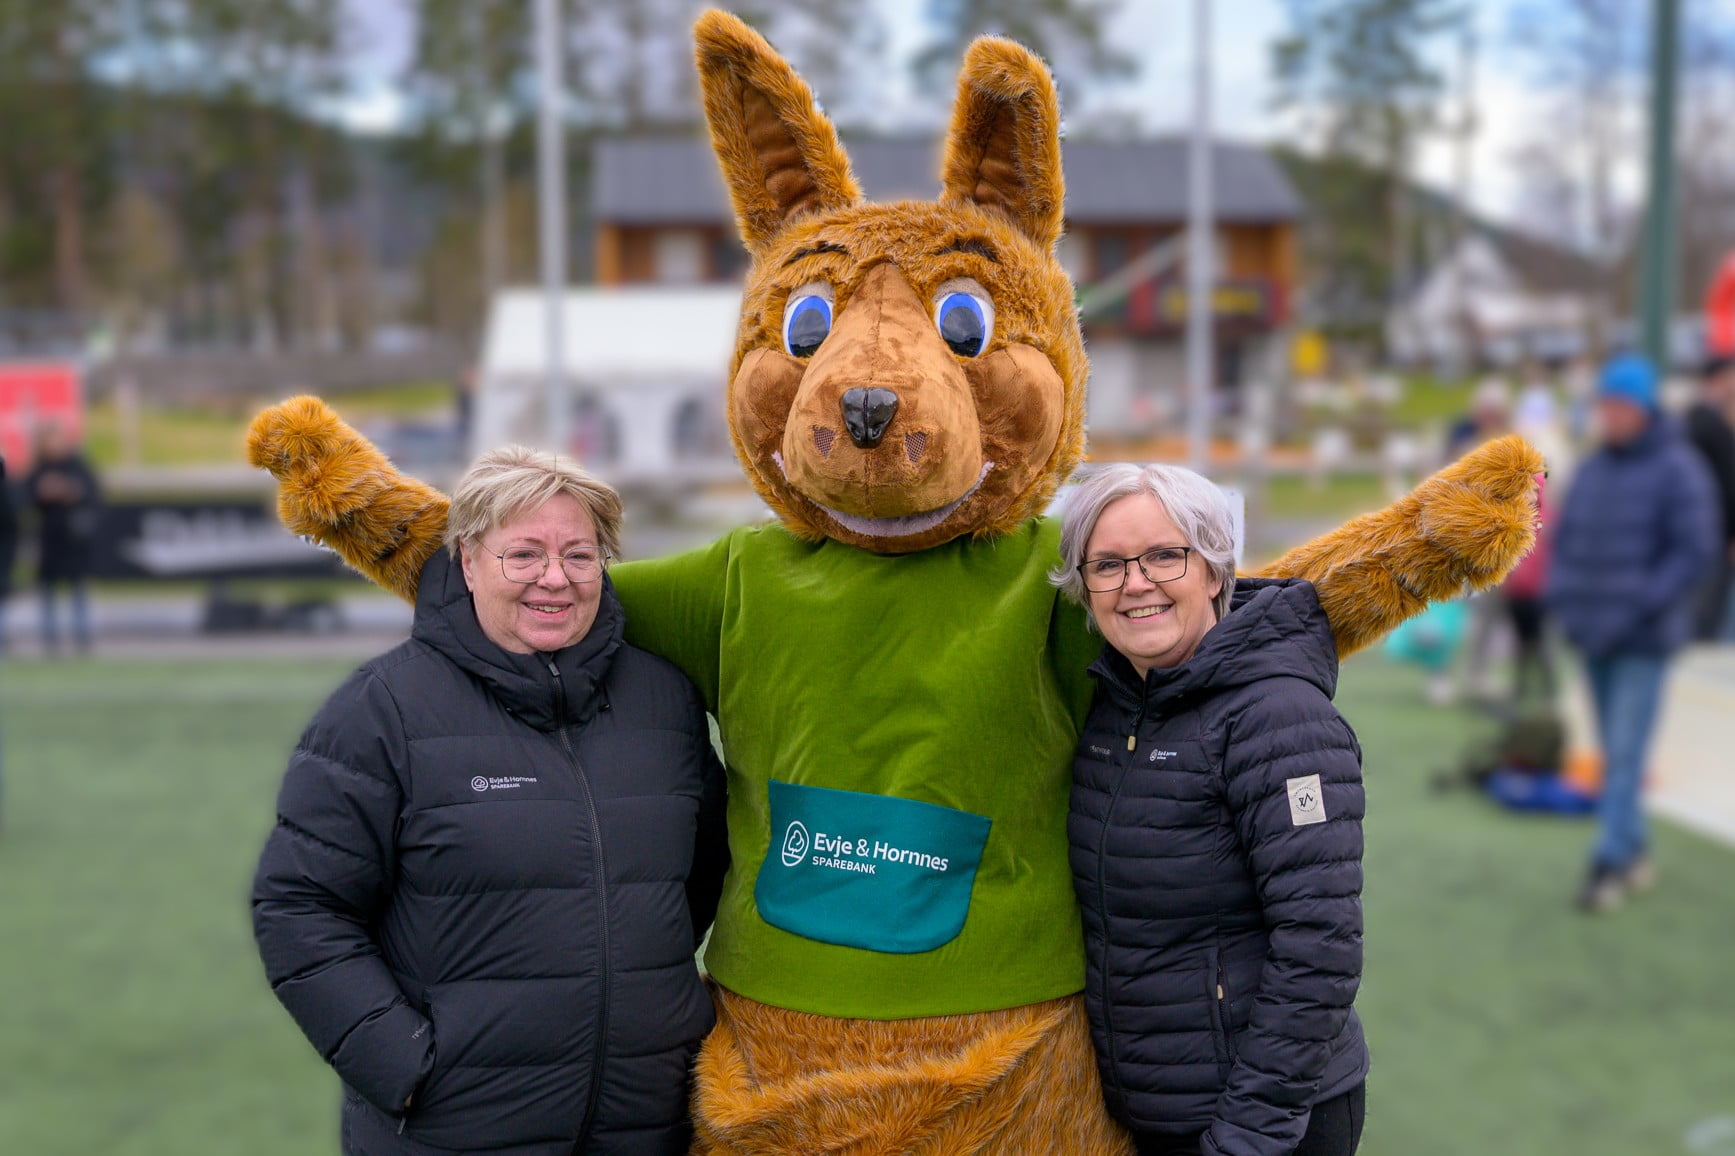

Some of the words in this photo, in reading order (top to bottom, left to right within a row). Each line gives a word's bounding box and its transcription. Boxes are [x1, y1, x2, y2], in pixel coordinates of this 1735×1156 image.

[489, 776, 503, 784] Evje
[813, 832, 852, 857] Evje
[855, 838, 869, 857] &
[872, 841, 949, 871] Hornnes
[811, 856, 876, 874] SPAREBANK
